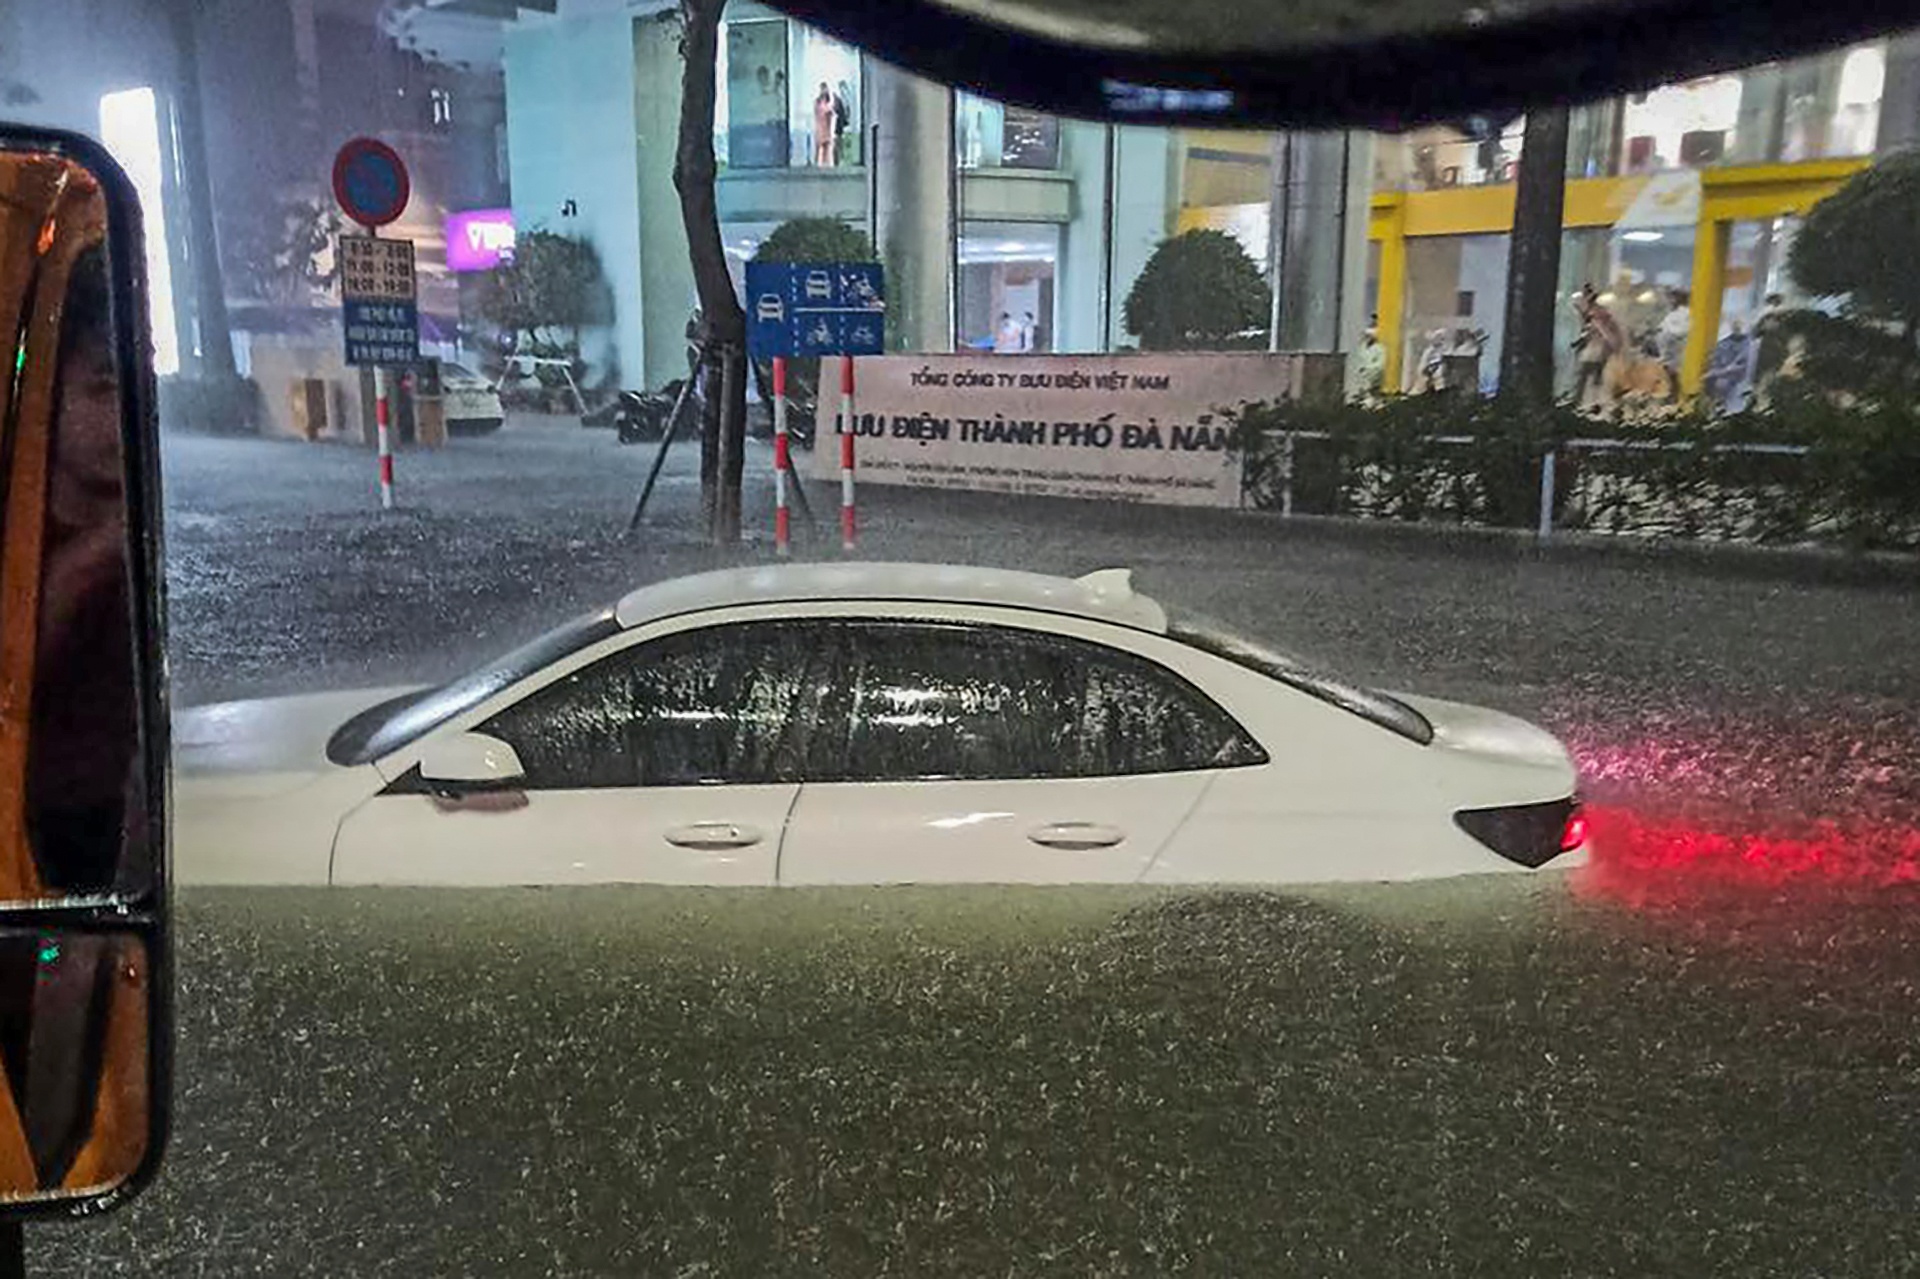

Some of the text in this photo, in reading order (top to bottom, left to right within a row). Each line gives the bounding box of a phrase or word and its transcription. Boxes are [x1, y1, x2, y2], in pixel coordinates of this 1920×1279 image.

[910, 366, 948, 386] TỔNG
[953, 368, 994, 387] CÔNG
[997, 373, 1017, 387] TY
[1094, 370, 1129, 391] VIỆT
[1132, 374, 1170, 391] NAM
[891, 412, 951, 447] ĐIỆN
[957, 412, 1046, 445] THÀNH
[1052, 412, 1117, 448] PHỐ
[1120, 417, 1165, 450] ĐÀ
